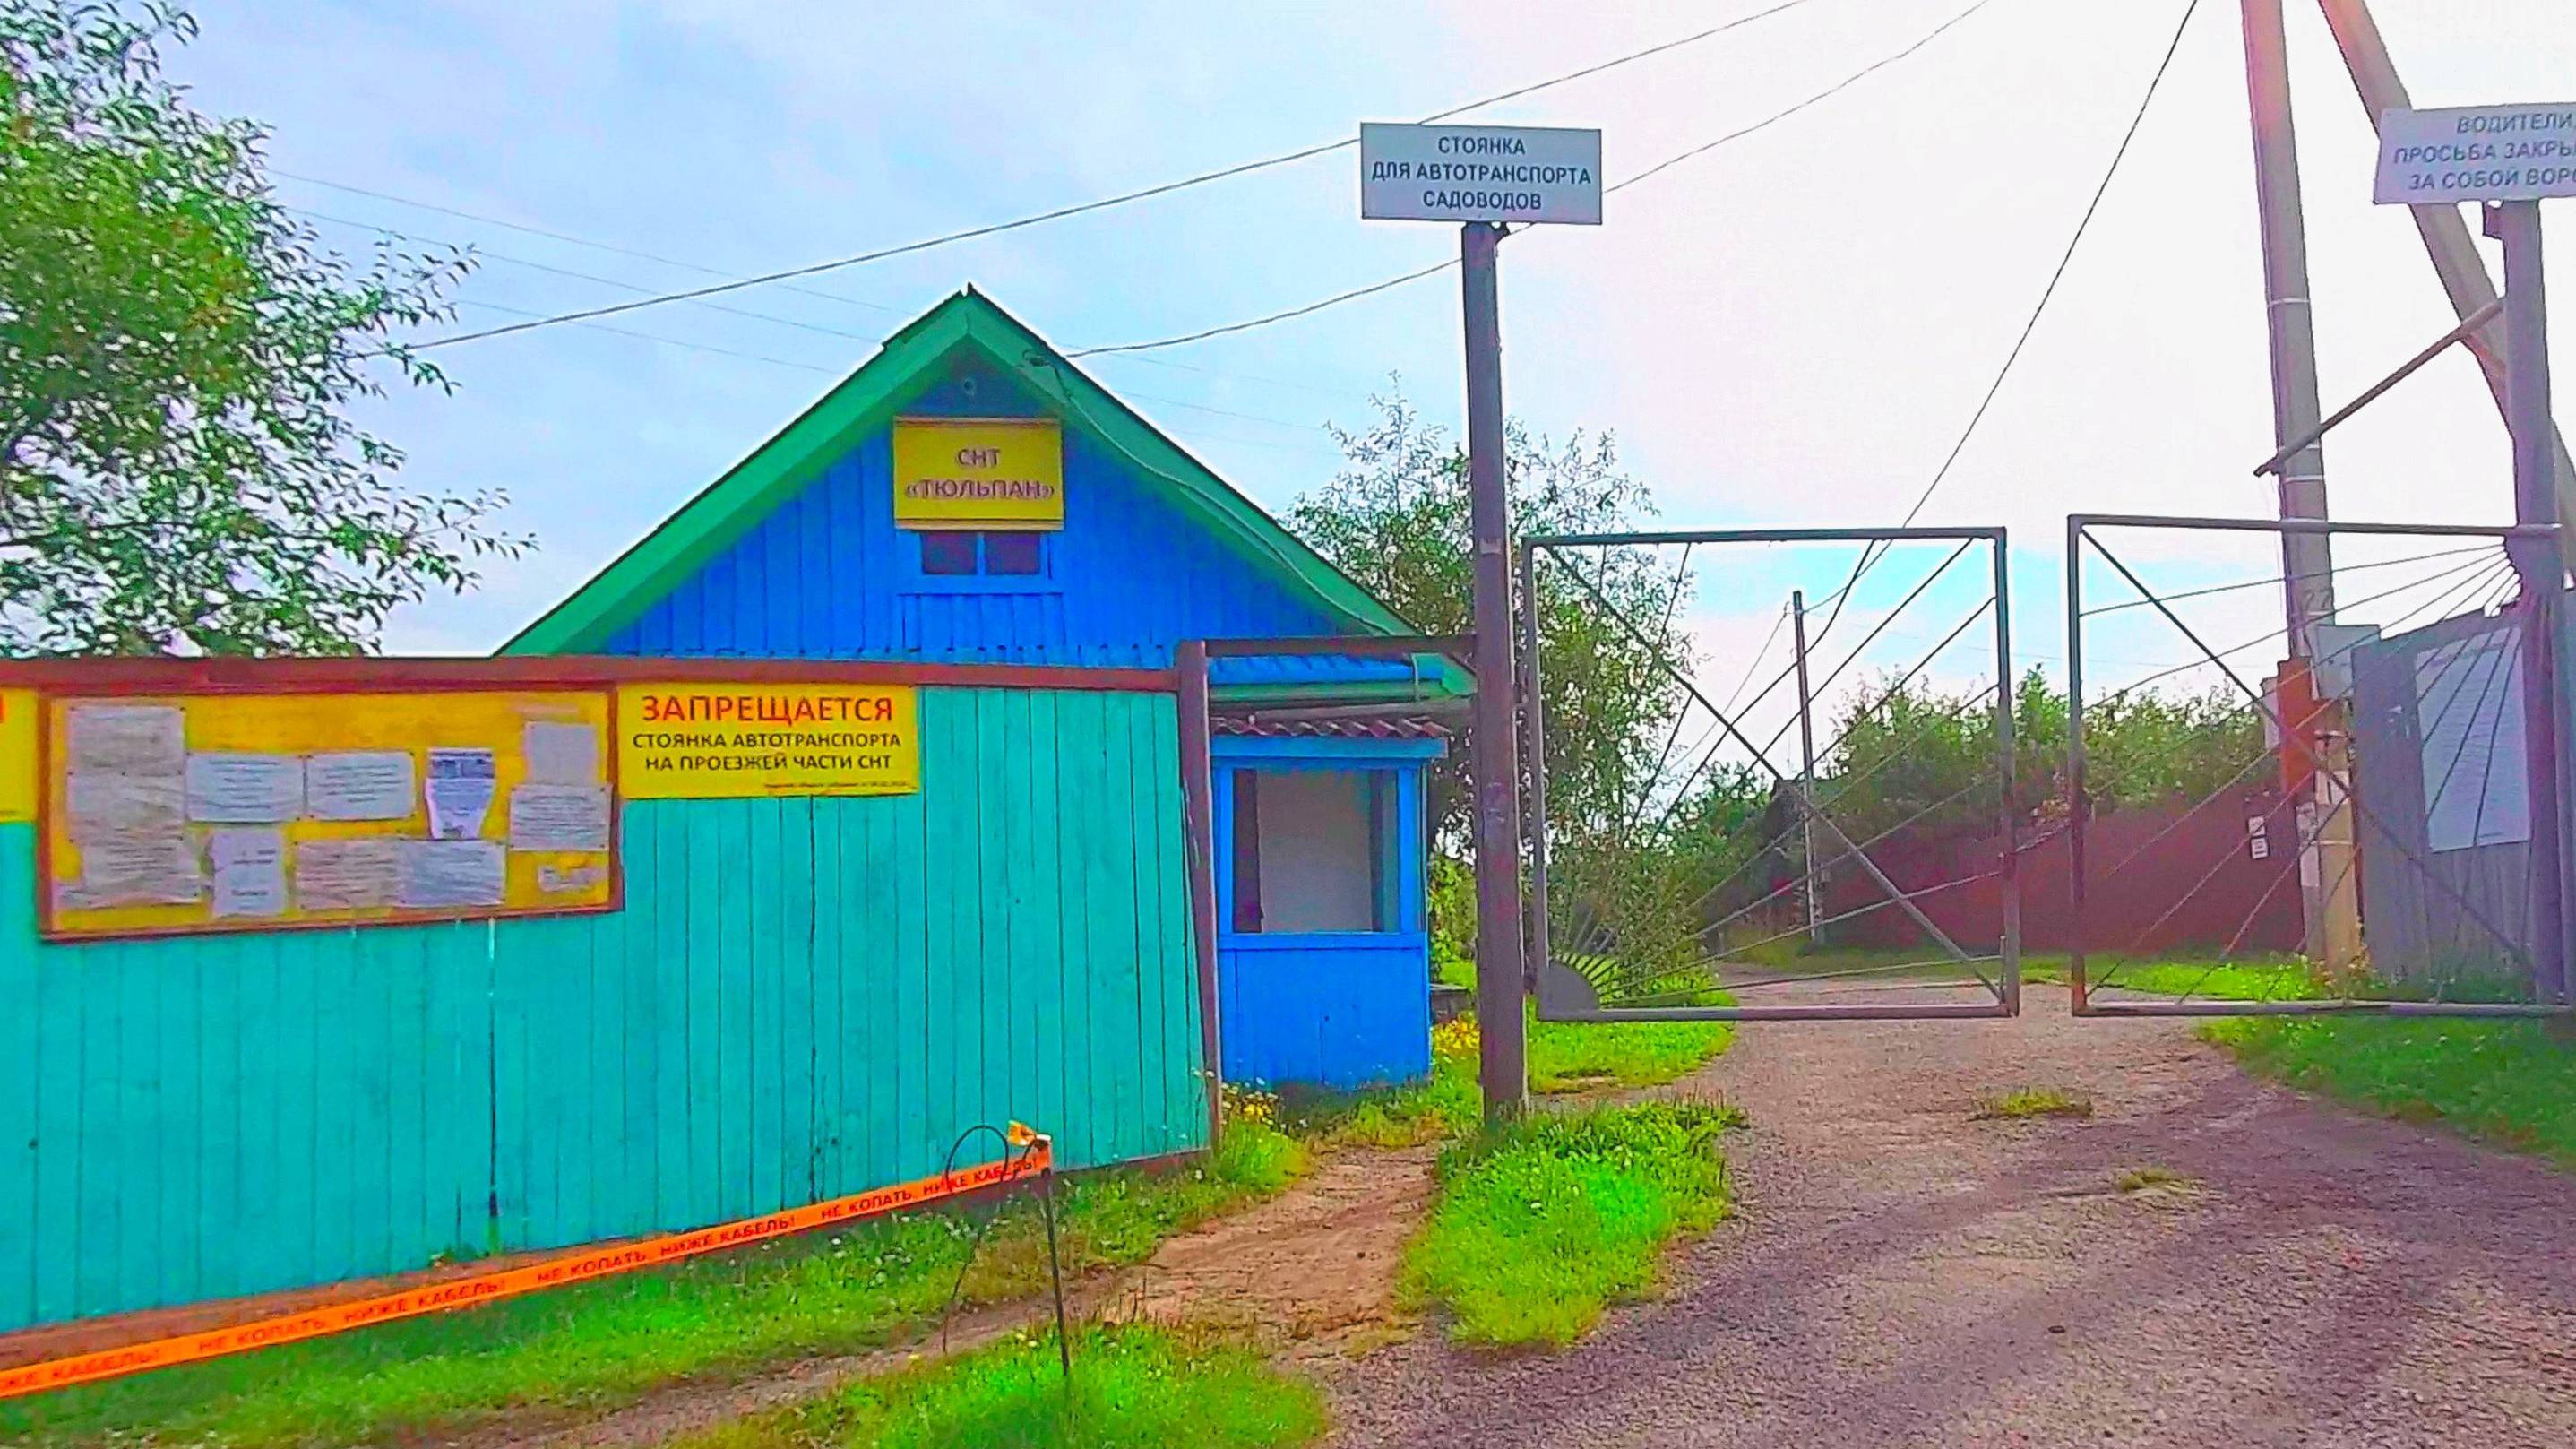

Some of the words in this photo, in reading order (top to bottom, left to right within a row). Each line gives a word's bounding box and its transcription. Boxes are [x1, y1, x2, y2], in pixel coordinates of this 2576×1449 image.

[1438, 136, 1526, 155] СТОЯНКА
[2394, 143, 2497, 164] ПРОСЬБА
[1372, 161, 1410, 181] ДЛЯ
[1416, 162, 1592, 185] АВТОТРАНСПОРТА
[2408, 173, 2435, 190] ЗА
[2442, 168, 2520, 190] СОБОЙ
[1423, 190, 1542, 211] САДОВОДОВ
[957, 449, 1001, 467] СНТ
[905, 479, 1055, 499] «ТЮЛЬПАН»
[642, 695, 893, 727] ЗАПРЕЩАЕТСЯ
[633, 732, 727, 749] СТОЯНКА
[733, 732, 901, 748] АВТОТРАНСПОРТА
[645, 757, 673, 772] НА
[680, 752, 788, 772] ПРОЕЗЖЕЙ
[794, 755, 853, 769] ЧАСТИ
[857, 755, 891, 769] СНТ
[570, 1250, 646, 1274] КОПАТЬ
[660, 1235, 712, 1255] НИЖЕ
[719, 1215, 796, 1244] КАБЕЛЬ!
[822, 1205, 841, 1220] НЕ
[849, 1190, 913, 1213] КОПАТЬ
